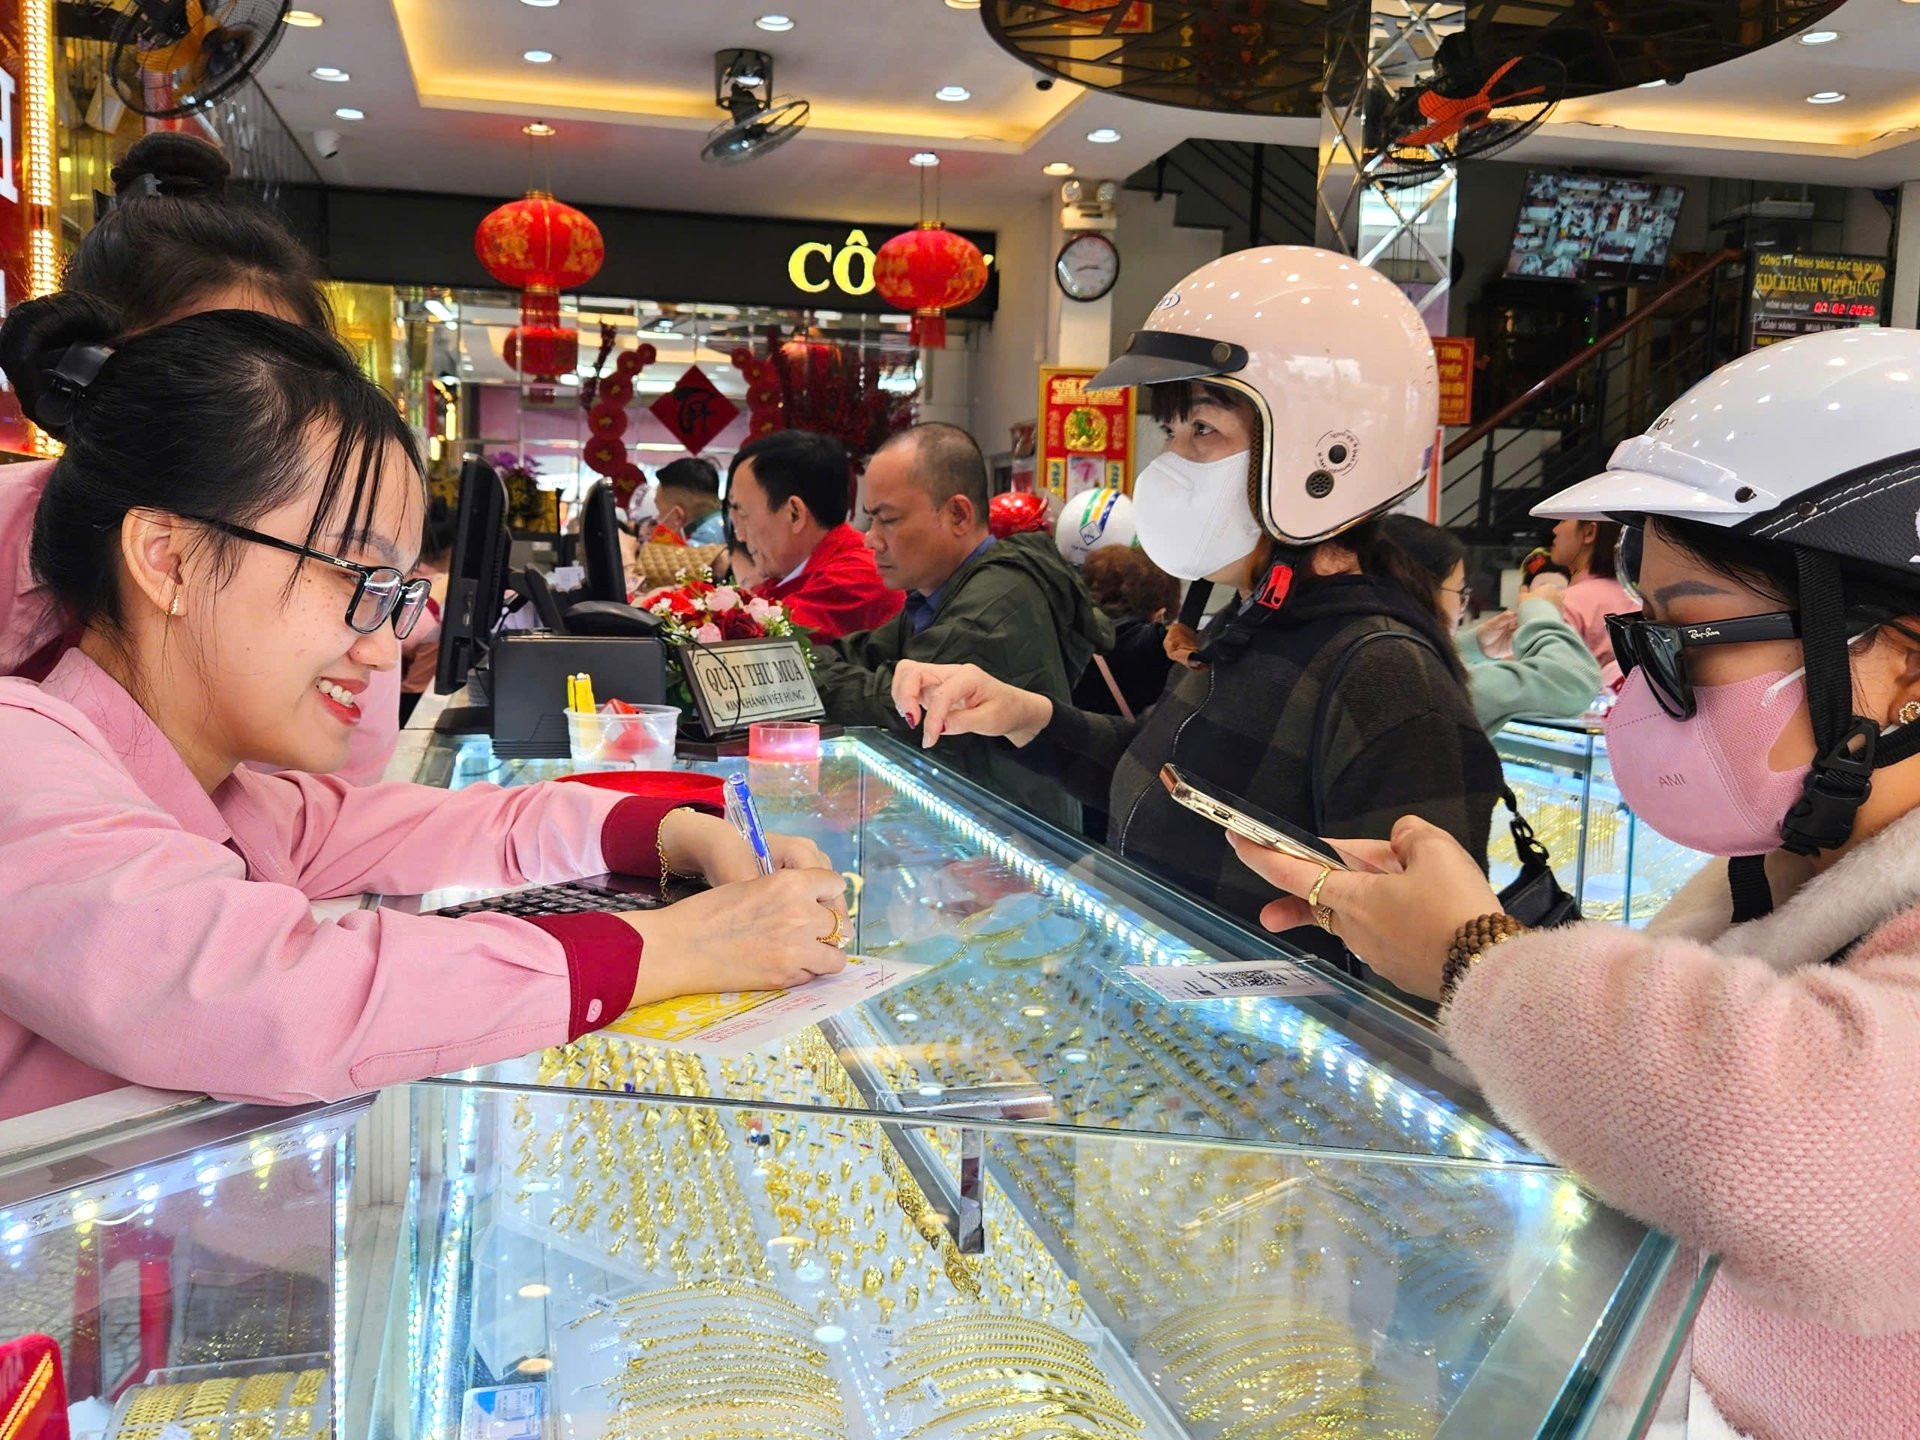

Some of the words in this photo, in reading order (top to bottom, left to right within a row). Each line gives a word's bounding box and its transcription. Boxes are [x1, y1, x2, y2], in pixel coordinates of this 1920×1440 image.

[1755, 273, 1777, 291] KIM
[1779, 270, 1819, 293] KHÁNH
[1688, 627, 1720, 640] Ray-Ban
[743, 661, 774, 687] THU
[772, 659, 805, 684] MUA
[740, 693, 768, 710] KHÁNH
[766, 689, 784, 706] VIỆT
[1659, 773, 1686, 788] AMI
